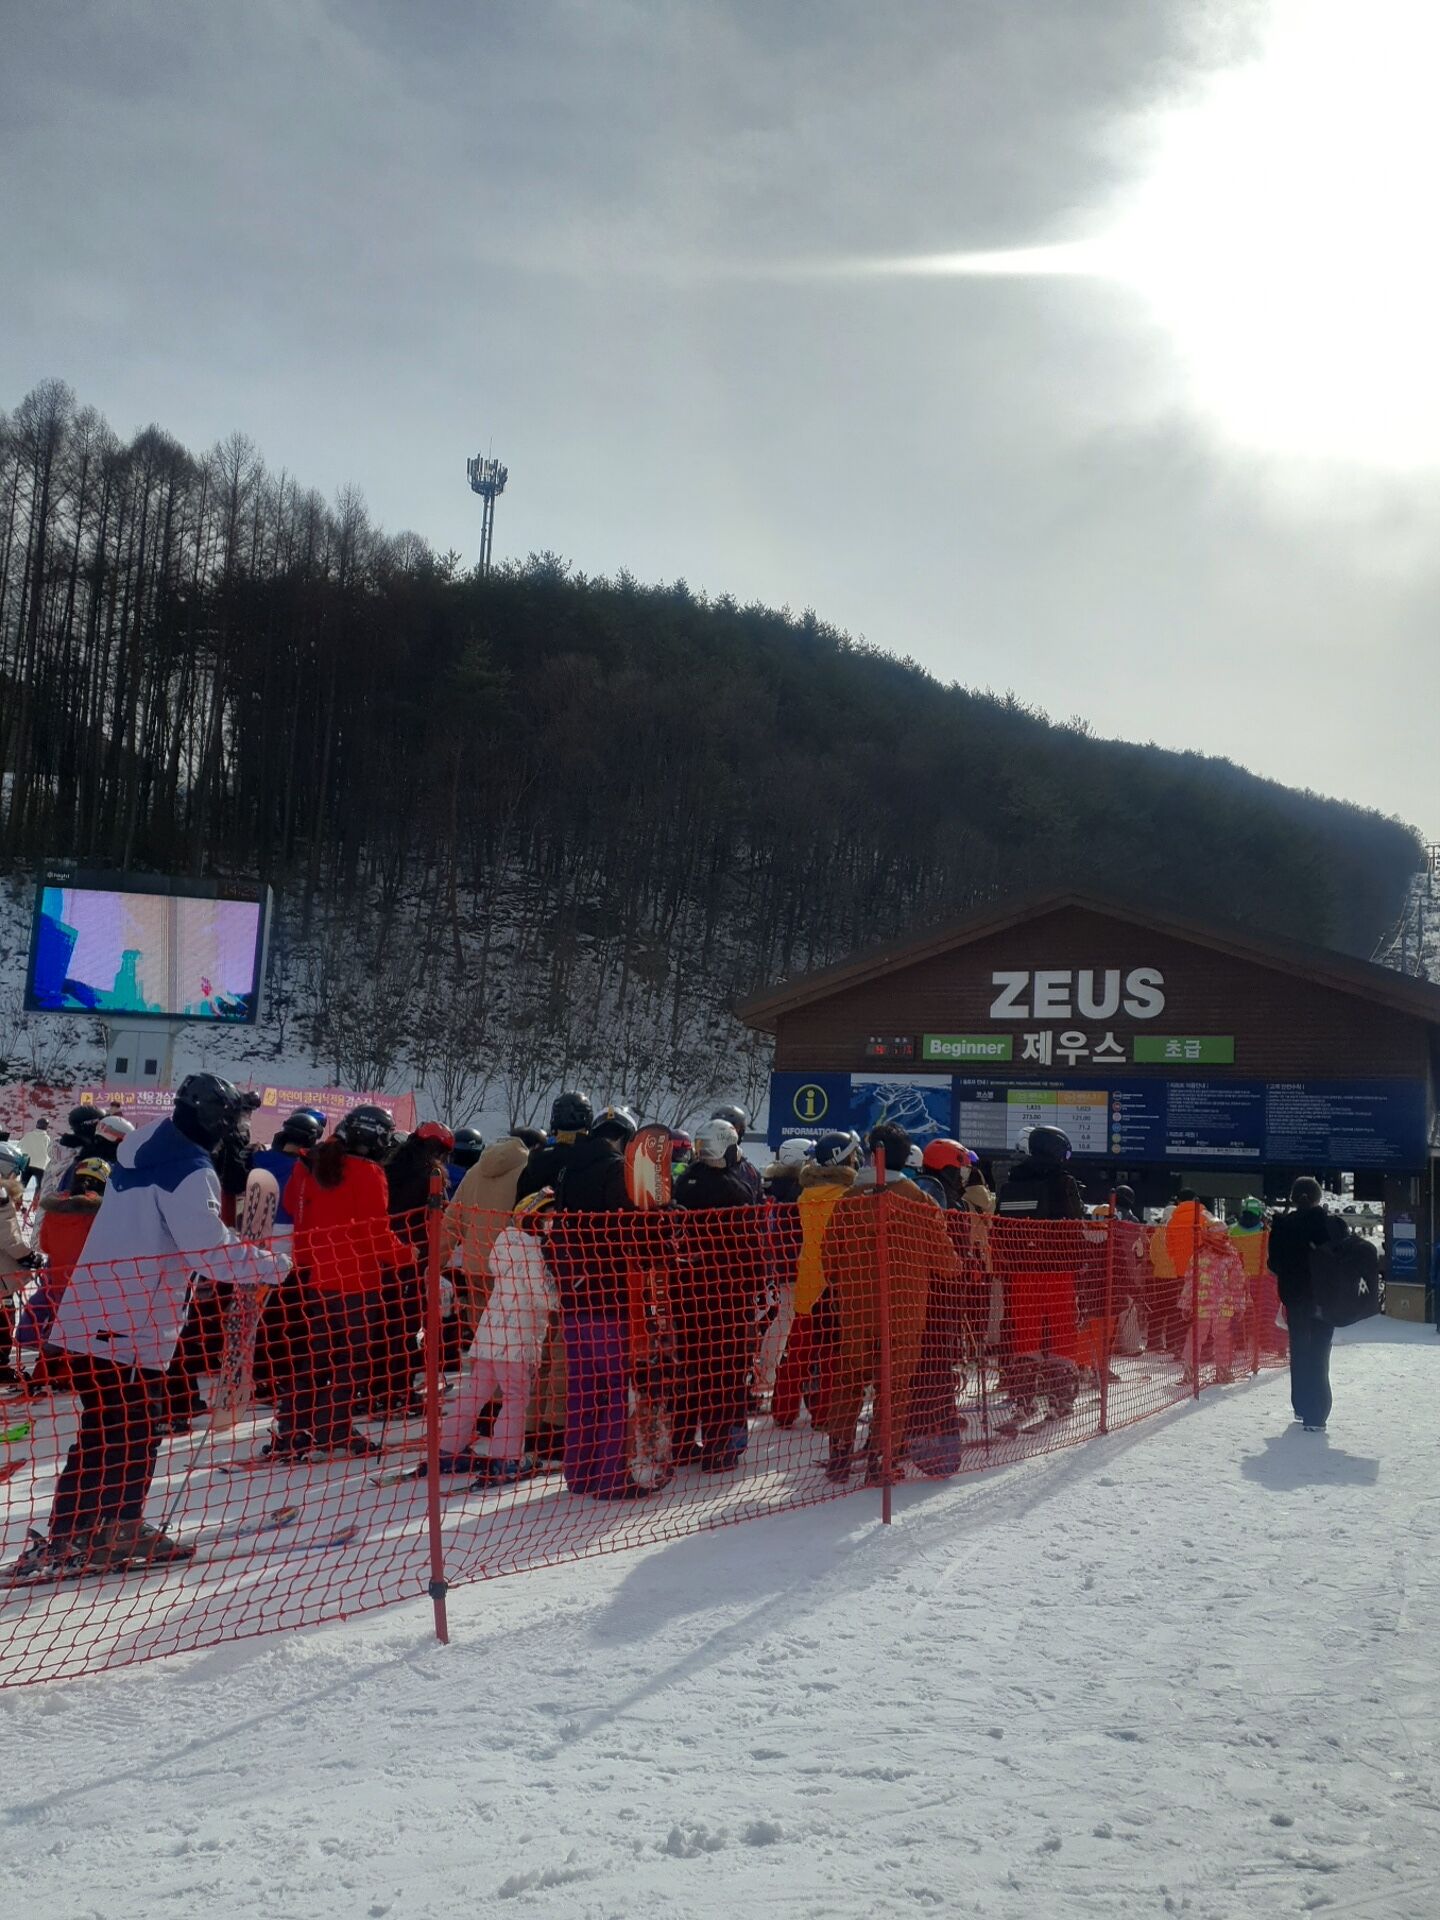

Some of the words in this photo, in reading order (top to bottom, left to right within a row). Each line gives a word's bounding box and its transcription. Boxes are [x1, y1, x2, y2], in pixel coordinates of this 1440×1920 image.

[990, 967, 1166, 1020] ZEUS
[930, 1040, 1005, 1057] Beginner
[1021, 1030, 1127, 1066] 제우스
[1165, 1040, 1202, 1059] 초급
